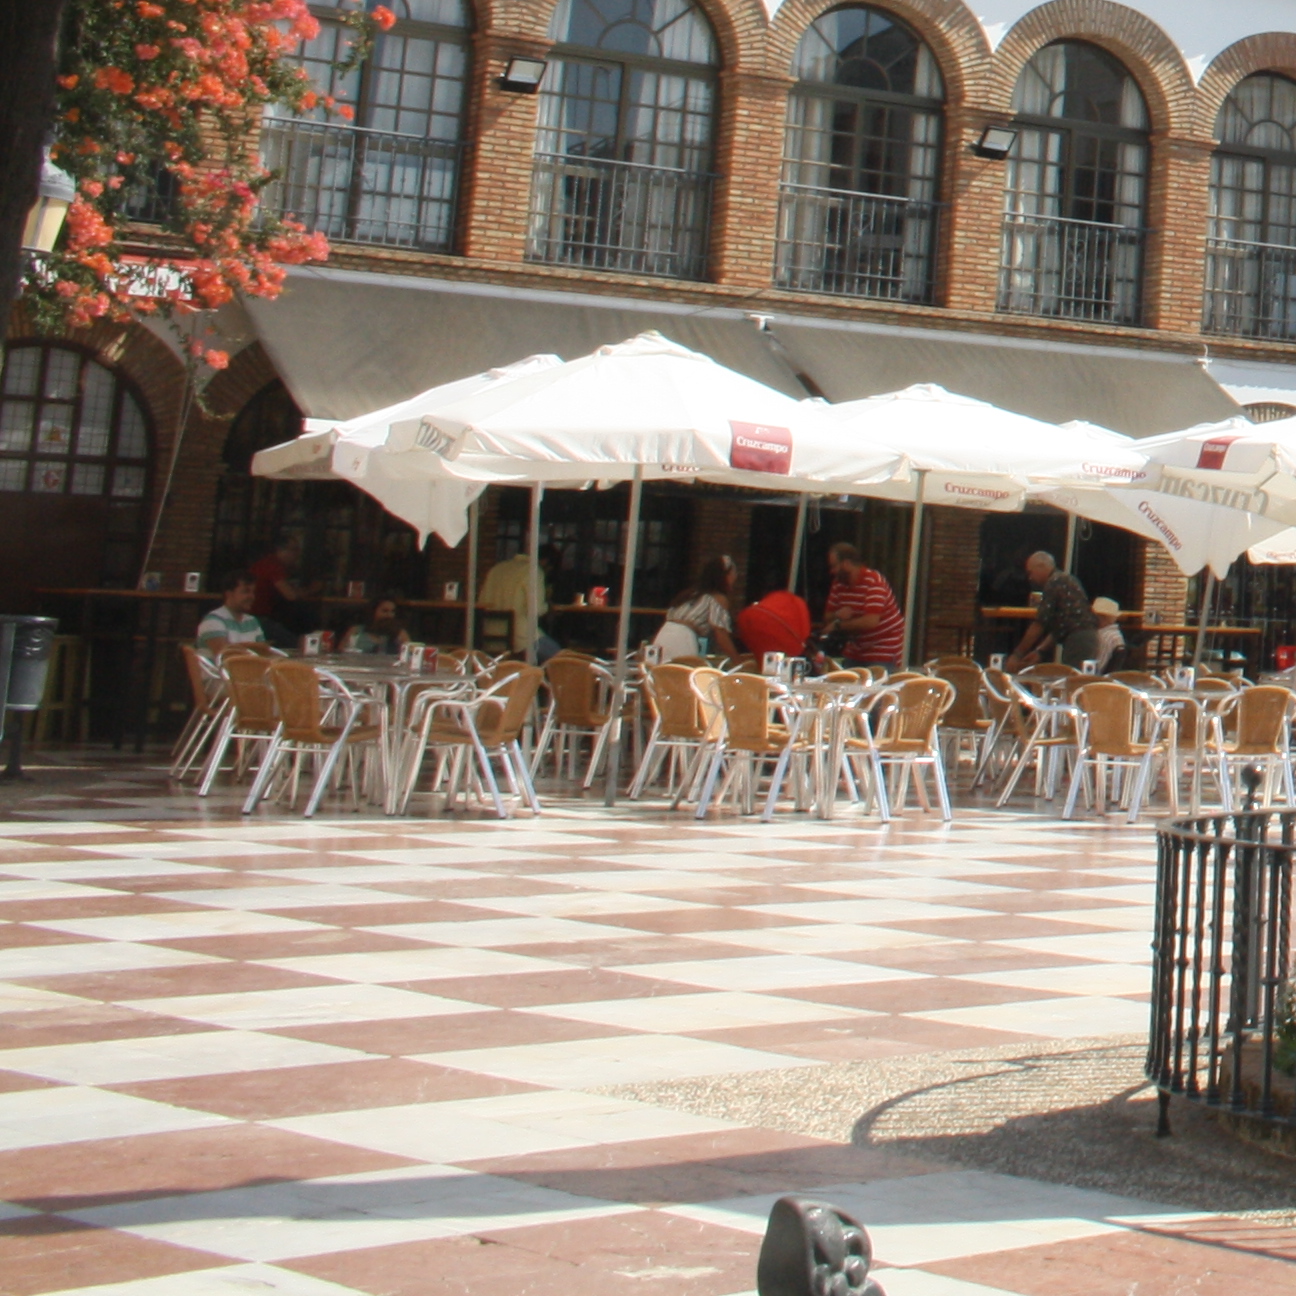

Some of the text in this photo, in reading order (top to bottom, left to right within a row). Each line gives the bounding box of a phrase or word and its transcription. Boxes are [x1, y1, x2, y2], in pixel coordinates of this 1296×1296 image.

[736, 435, 789, 454] Cruzcampo
[1082, 461, 1147, 480] Cruzcampo
[944, 482, 1010, 500] Cruzcampo
[1138, 500, 1182, 552] Cruzcampo
